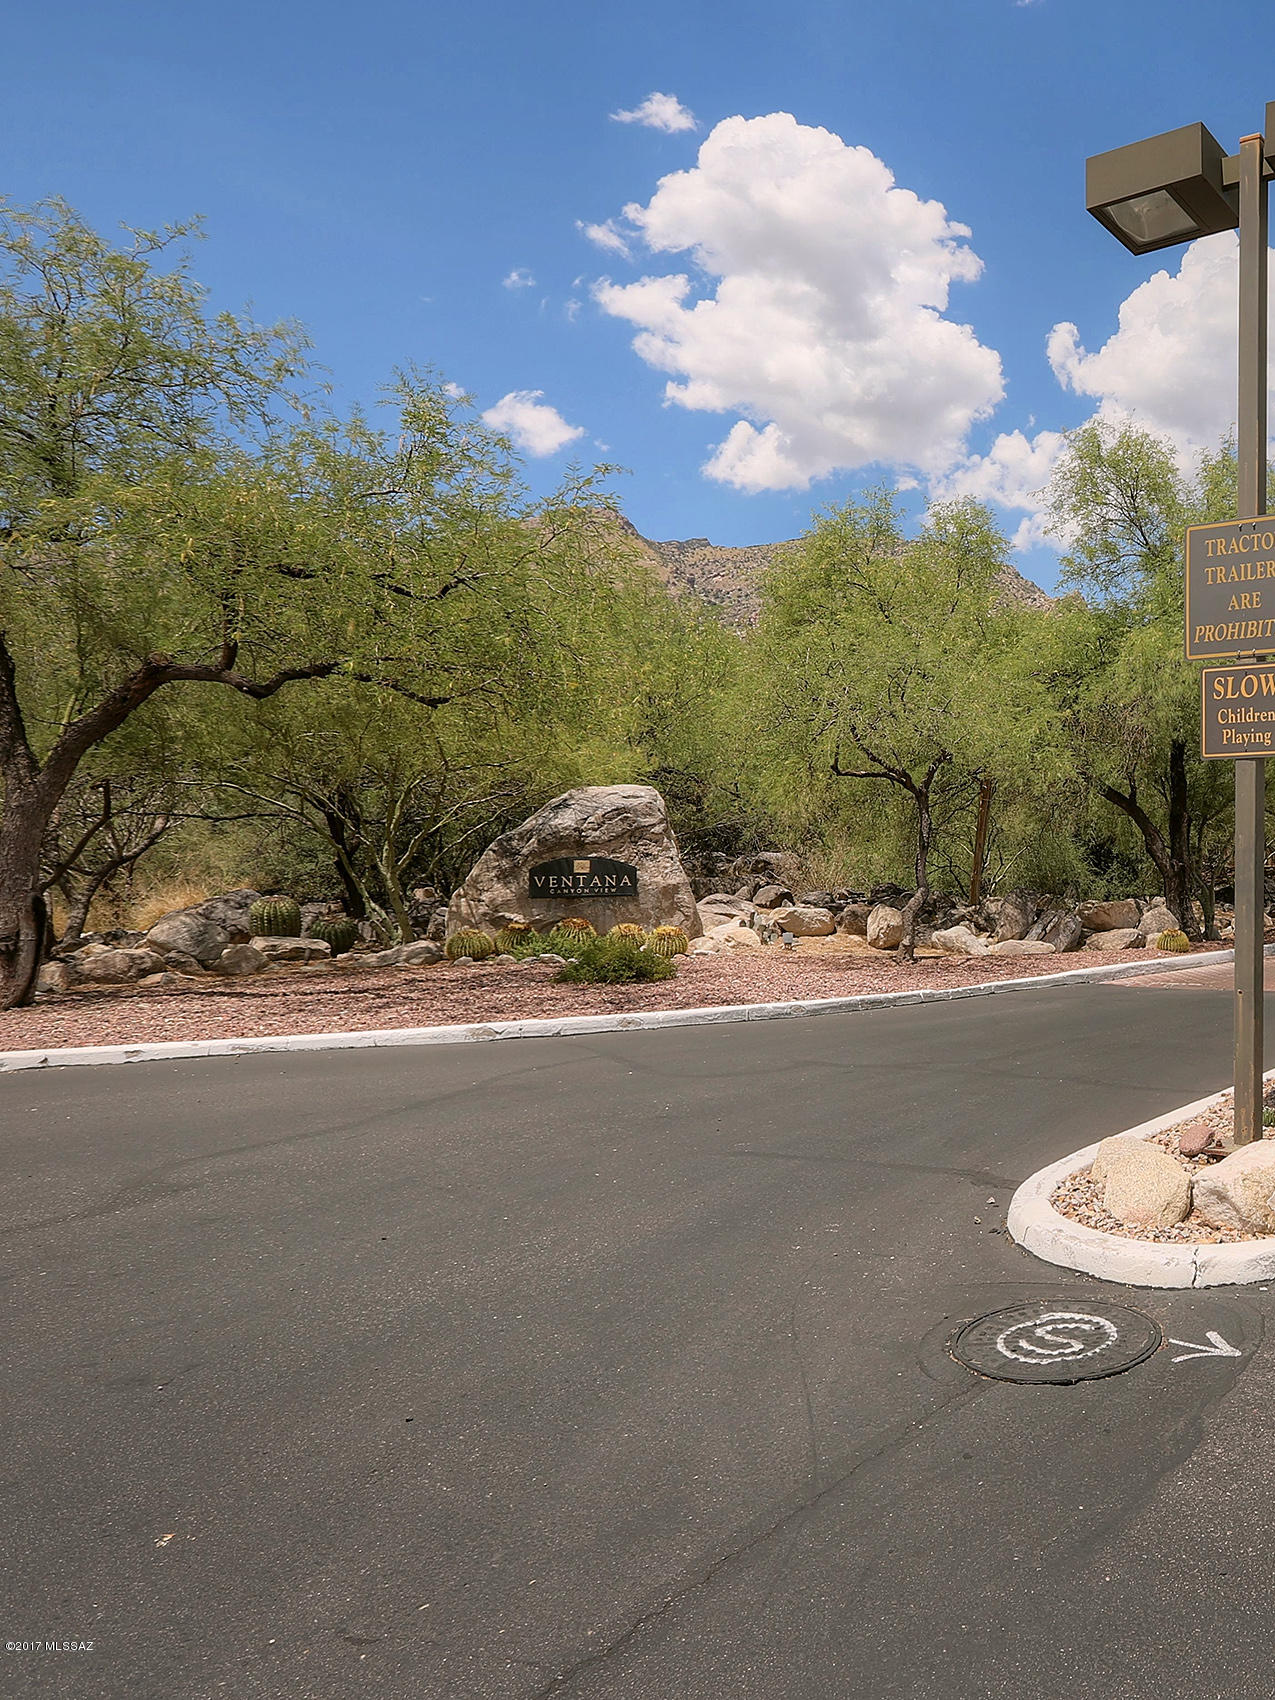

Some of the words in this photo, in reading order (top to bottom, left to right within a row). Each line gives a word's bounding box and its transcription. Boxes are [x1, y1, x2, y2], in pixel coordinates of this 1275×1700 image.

[1228, 591, 1262, 611] ARE
[1217, 706, 1275, 725] Children
[1222, 729, 1272, 746] Playing
[534, 874, 632, 888] VENTANA
[549, 887, 590, 895] CANYON
